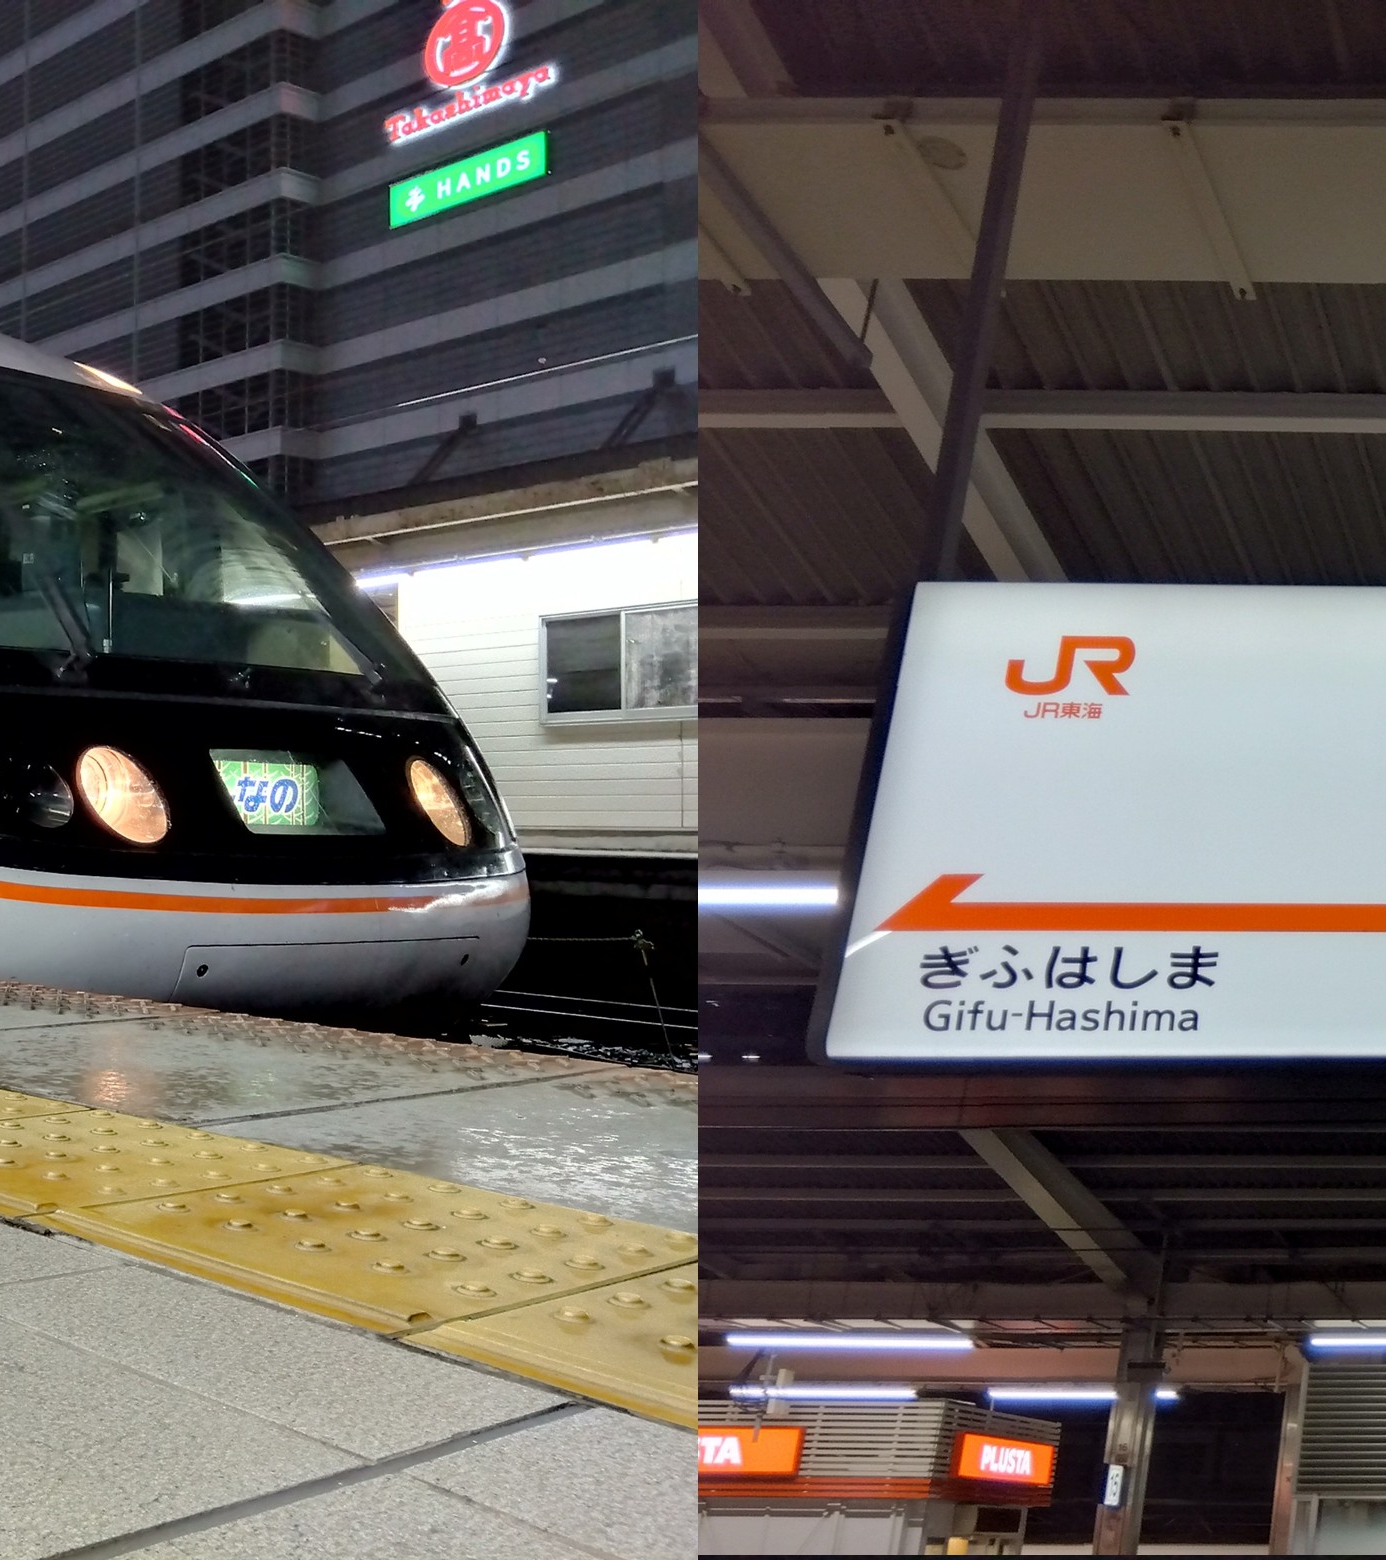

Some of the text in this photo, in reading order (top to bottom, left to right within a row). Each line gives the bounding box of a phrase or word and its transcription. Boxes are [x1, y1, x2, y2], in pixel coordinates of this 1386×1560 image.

[383, 65, 551, 143] Takashimaya
[436, 149, 531, 200] HANDS
[1005, 636, 1135, 695] JR
[1023, 701, 1103, 720] JR東海
[232, 775, 299, 814] なの
[919, 943, 1219, 991] ぎふはしま
[922, 999, 1200, 1033] Gifu-Hashima
[698, 1436, 742, 1464] TA
[980, 1444, 1031, 1476] PLUSTA
